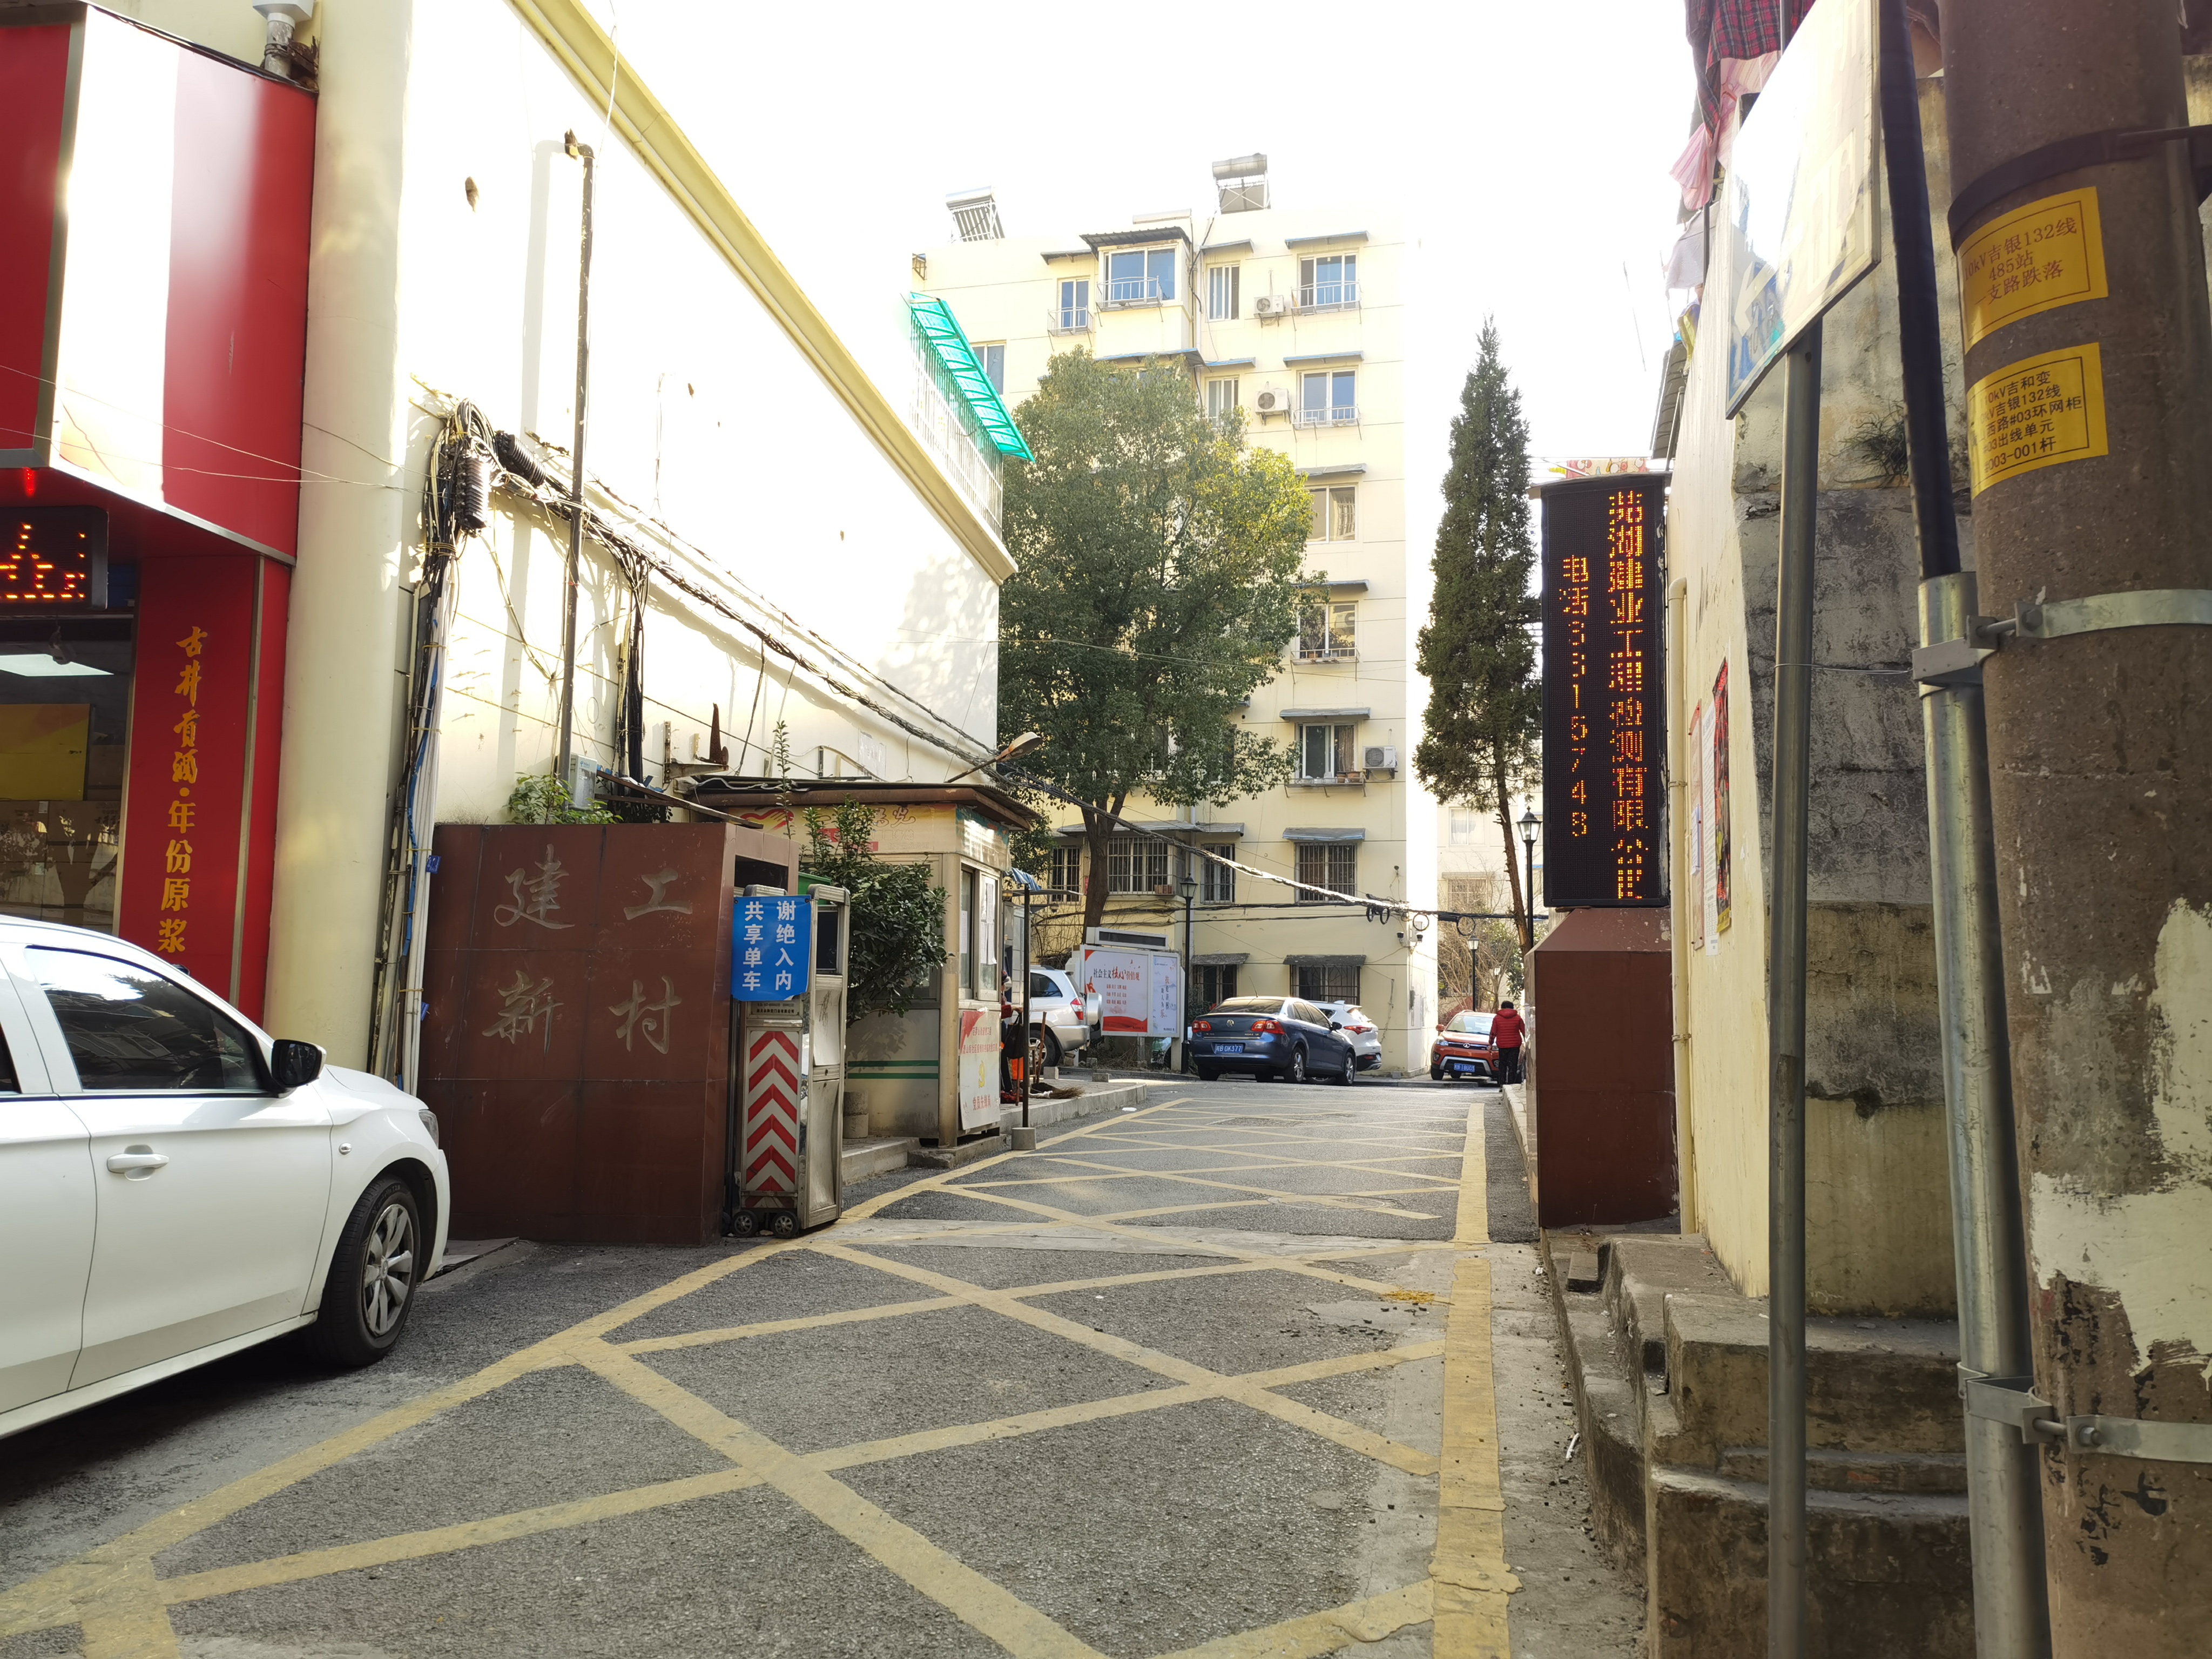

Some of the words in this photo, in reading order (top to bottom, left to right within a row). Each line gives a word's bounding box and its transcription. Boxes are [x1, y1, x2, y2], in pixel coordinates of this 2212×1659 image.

[1988, 249, 2034, 281] 485站
[742, 901, 765, 992] 共享单车
[775, 900, 797, 991] 谢绝入内
[1093, 966, 1140, 981] 社会主义核心价值观
[972, 1094, 992, 1111] 党员先锋岗
